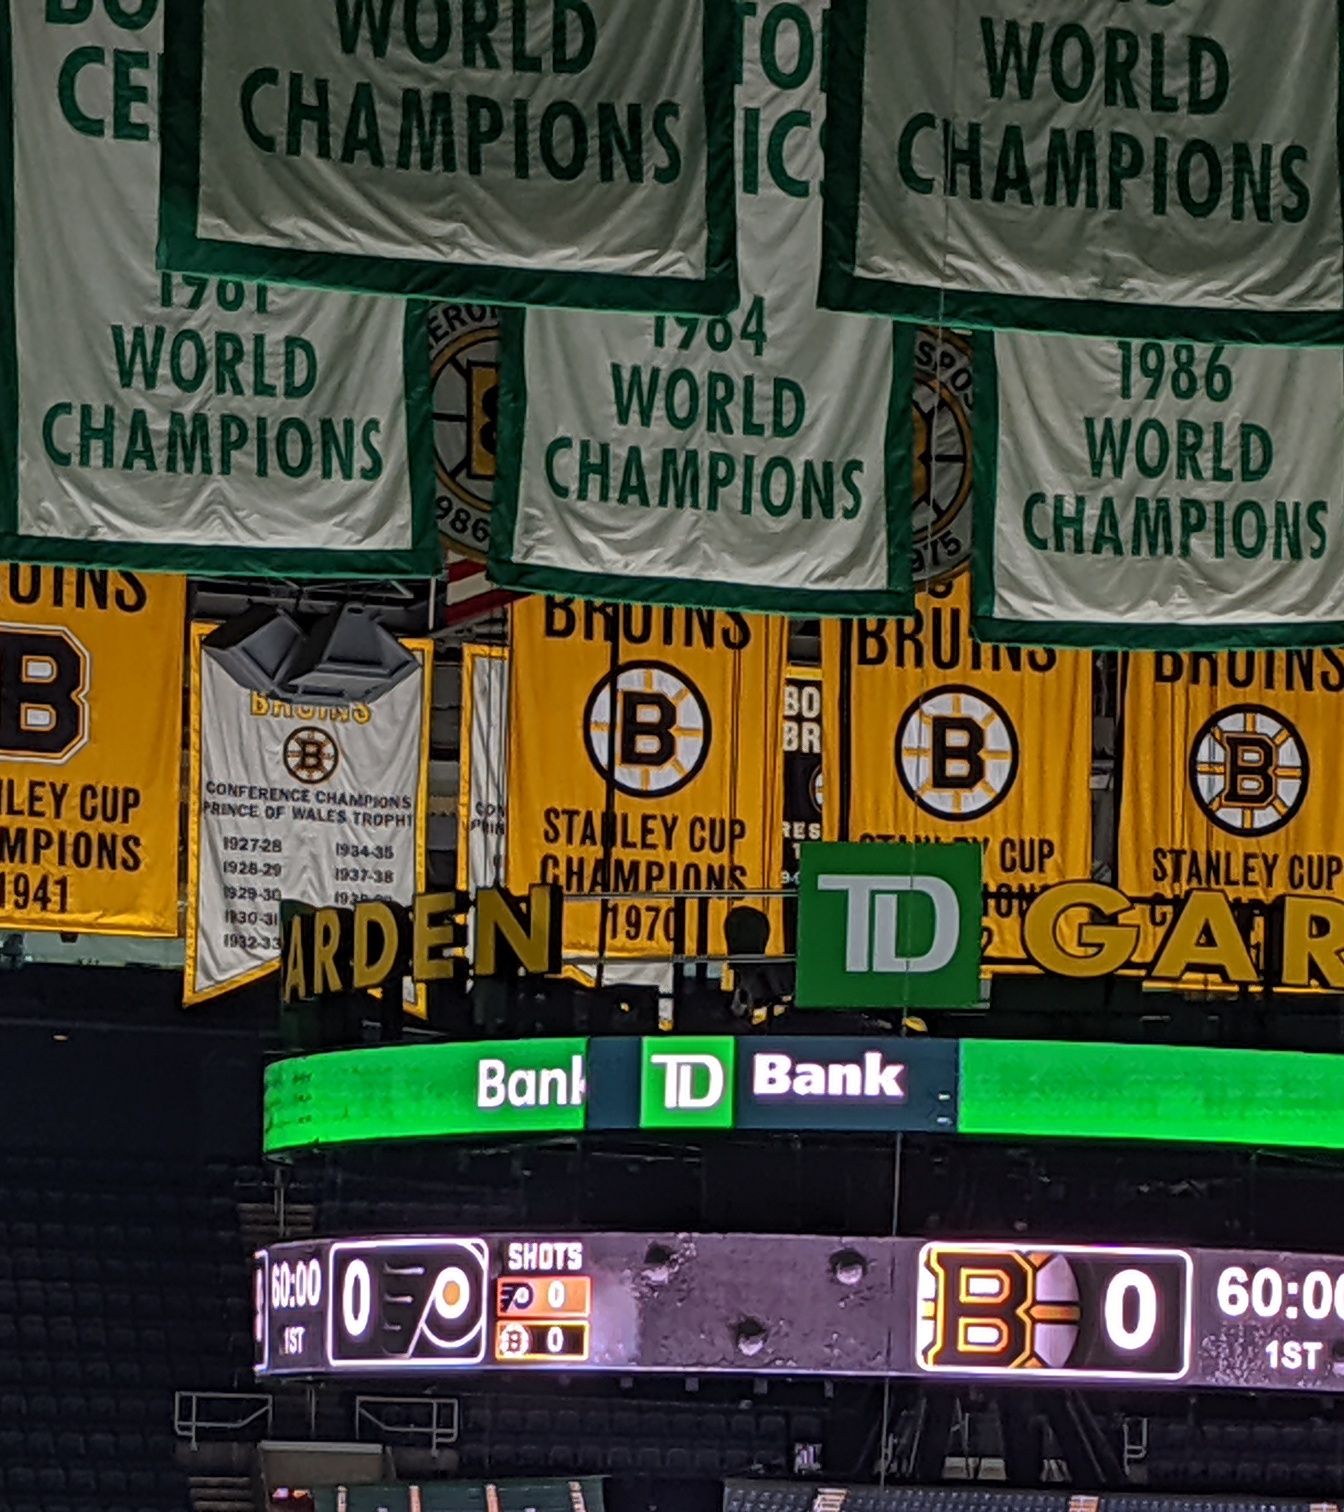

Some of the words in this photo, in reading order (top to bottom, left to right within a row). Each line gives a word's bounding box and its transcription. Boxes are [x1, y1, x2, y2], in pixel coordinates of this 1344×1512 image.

[336, 0, 598, 76] WORLD
[980, 16, 1232, 116] WORLD
[239, 67, 683, 185] CHAMPIONS
[897, 112, 1312, 224] CHAMPIONS
[111, 324, 318, 400] WORLD
[1117, 340, 1234, 403] 1986
[610, 362, 807, 438] WORLD
[42, 402, 385, 483] CHAMPIONS
[1084, 416, 1274, 483] WORLD
[545, 436, 864, 520] CHAMPIONS
[1023, 491, 1328, 562] CHAMPIONS
[79, 785, 142, 824] CUP
[203, 801, 257, 819] PRINCE
[264, 805, 285, 821] OF
[292, 807, 348, 824] WALES
[206, 780, 311, 804] CONFERENCE
[315, 790, 413, 810] CHAMPIONS
[689, 815, 747, 854] CUP
[999, 838, 1055, 875] CUP
[1152, 848, 1279, 889] STANLEY
[1288, 855, 1344, 892] CUP
[282, 884, 551, 1003] ARDEN
[817, 873, 960, 975] TD
[651, 1053, 725, 1110] TD
[753, 1050, 906, 1100] Bank
[270, 1258, 322, 1309] 60:00
[507, 1241, 583, 1270] SHOTS
[342, 1258, 371, 1337] 0
[547, 1280, 565, 1308] 0
[1105, 1269, 1157, 1349] 0
[283, 1327, 306, 1355] 1ST
[546, 1326, 564, 1353] 0
[1265, 1339, 1324, 1371] 1ST
